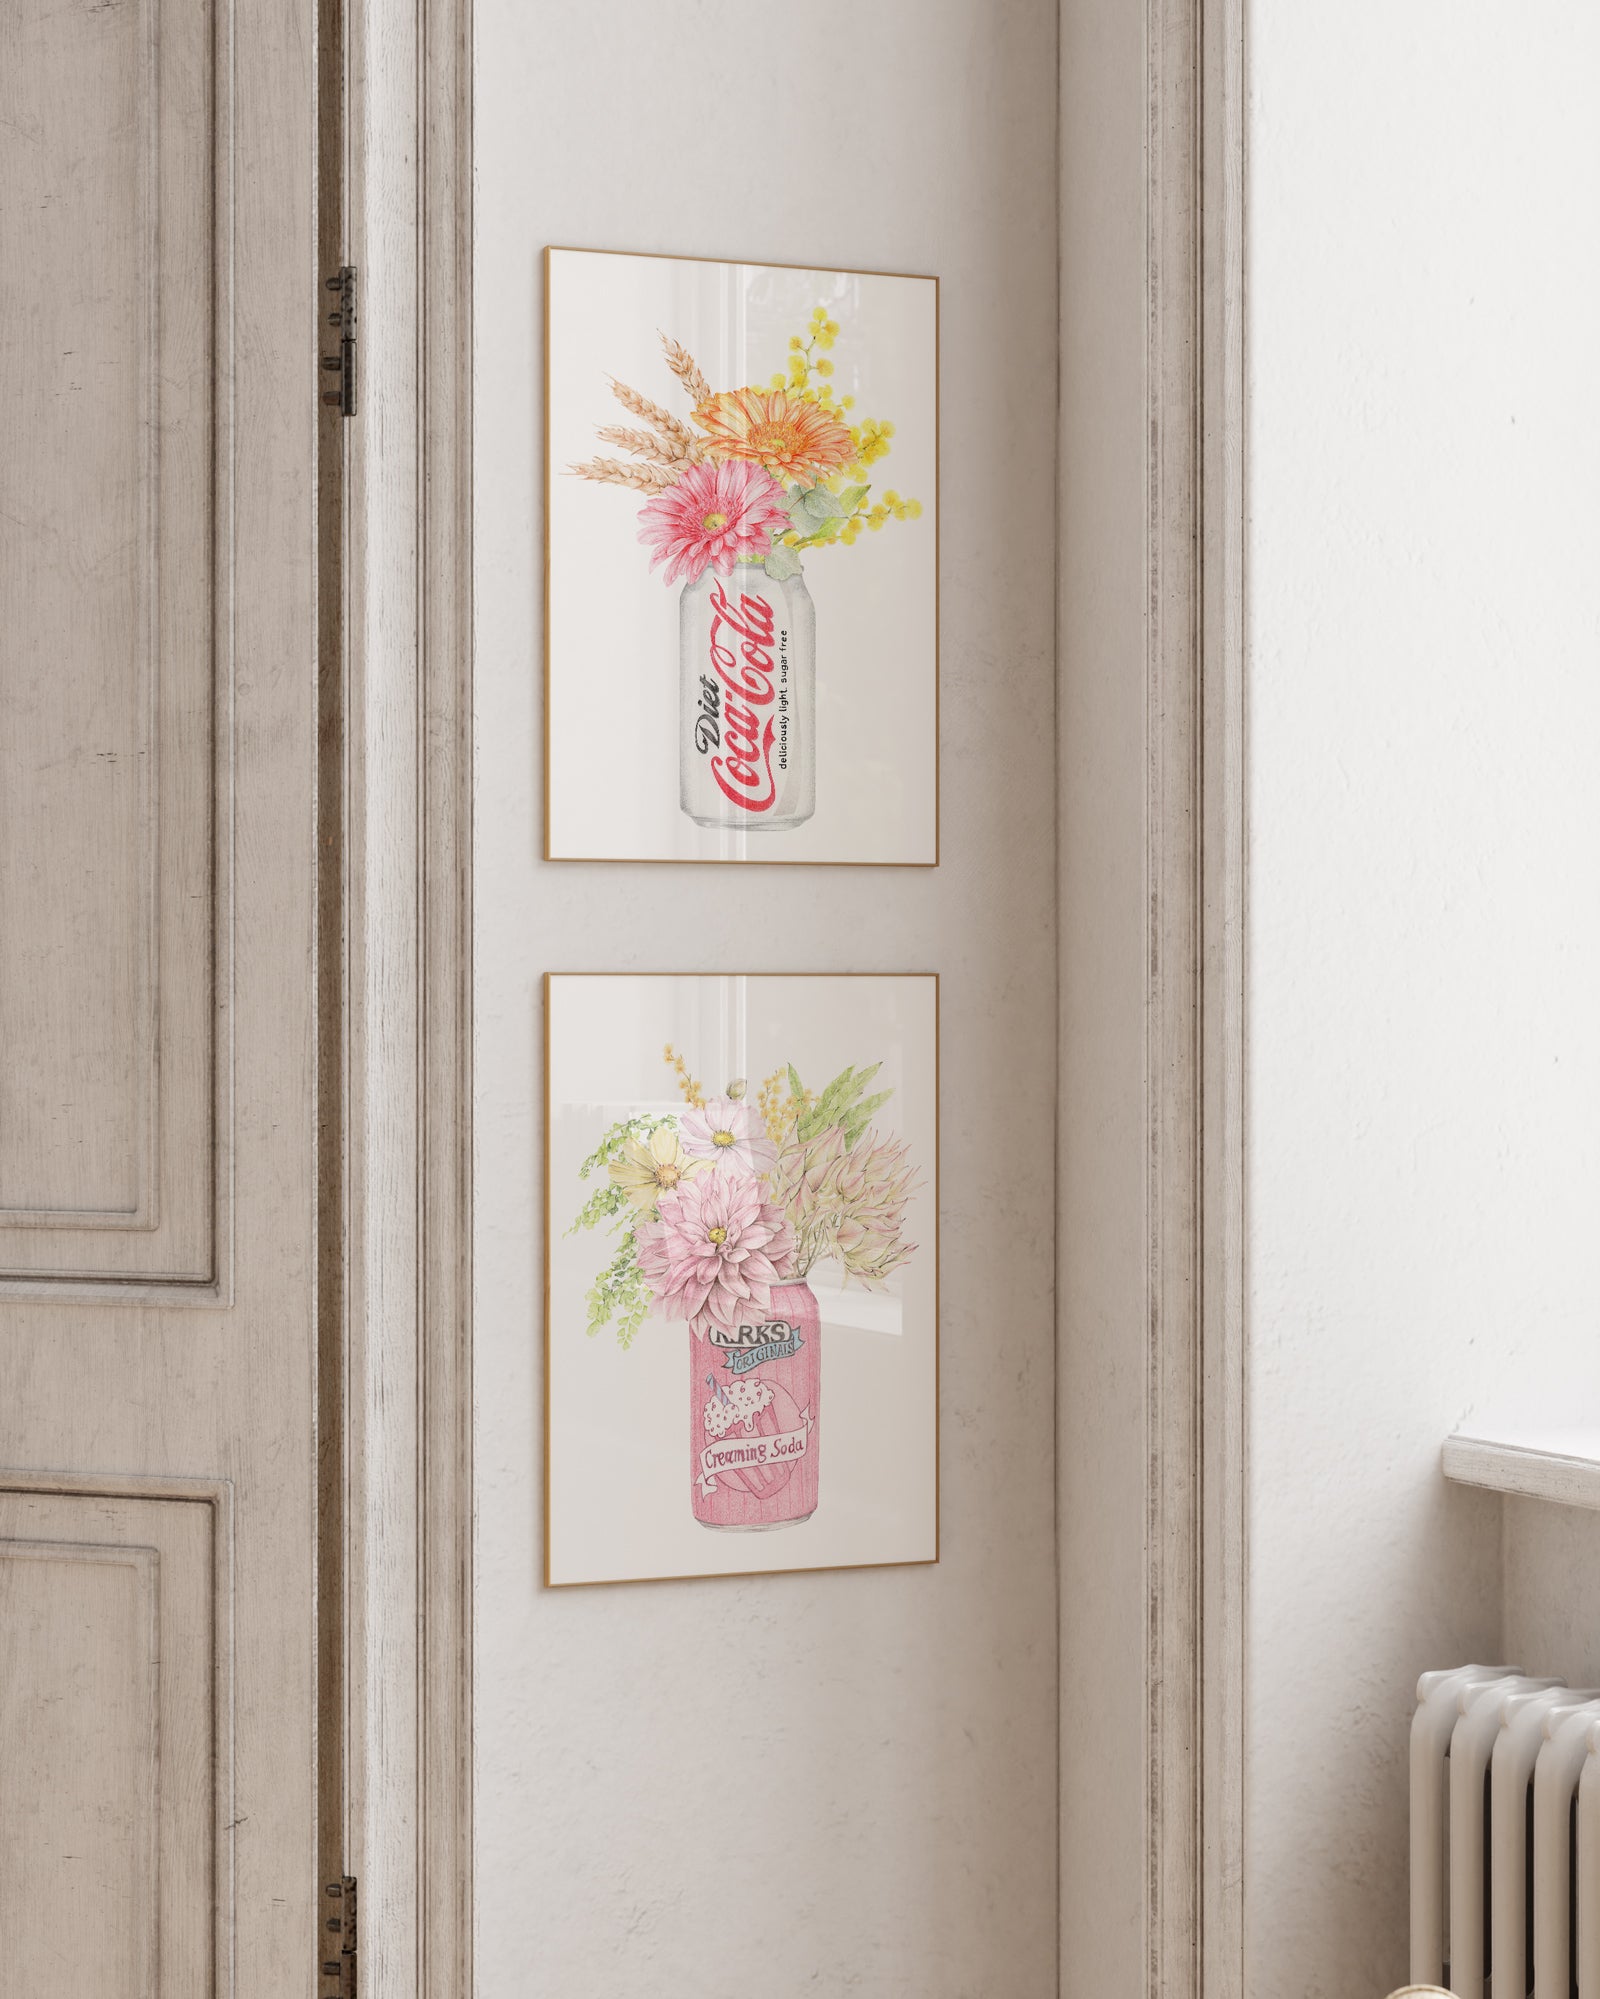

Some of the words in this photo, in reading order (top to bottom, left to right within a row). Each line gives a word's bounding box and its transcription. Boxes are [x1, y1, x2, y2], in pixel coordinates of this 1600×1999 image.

[778, 630, 788, 652] free
[779, 655, 789, 684] sugar
[694, 674, 721, 755] Diet
[778, 715, 790, 770] deliciously
[715, 1323, 786, 1345] KRKS
[736, 1342, 794, 1370] ORIGINALS
[705, 1444, 767, 1469] Creaming
[770, 1436, 804, 1458] Soda
